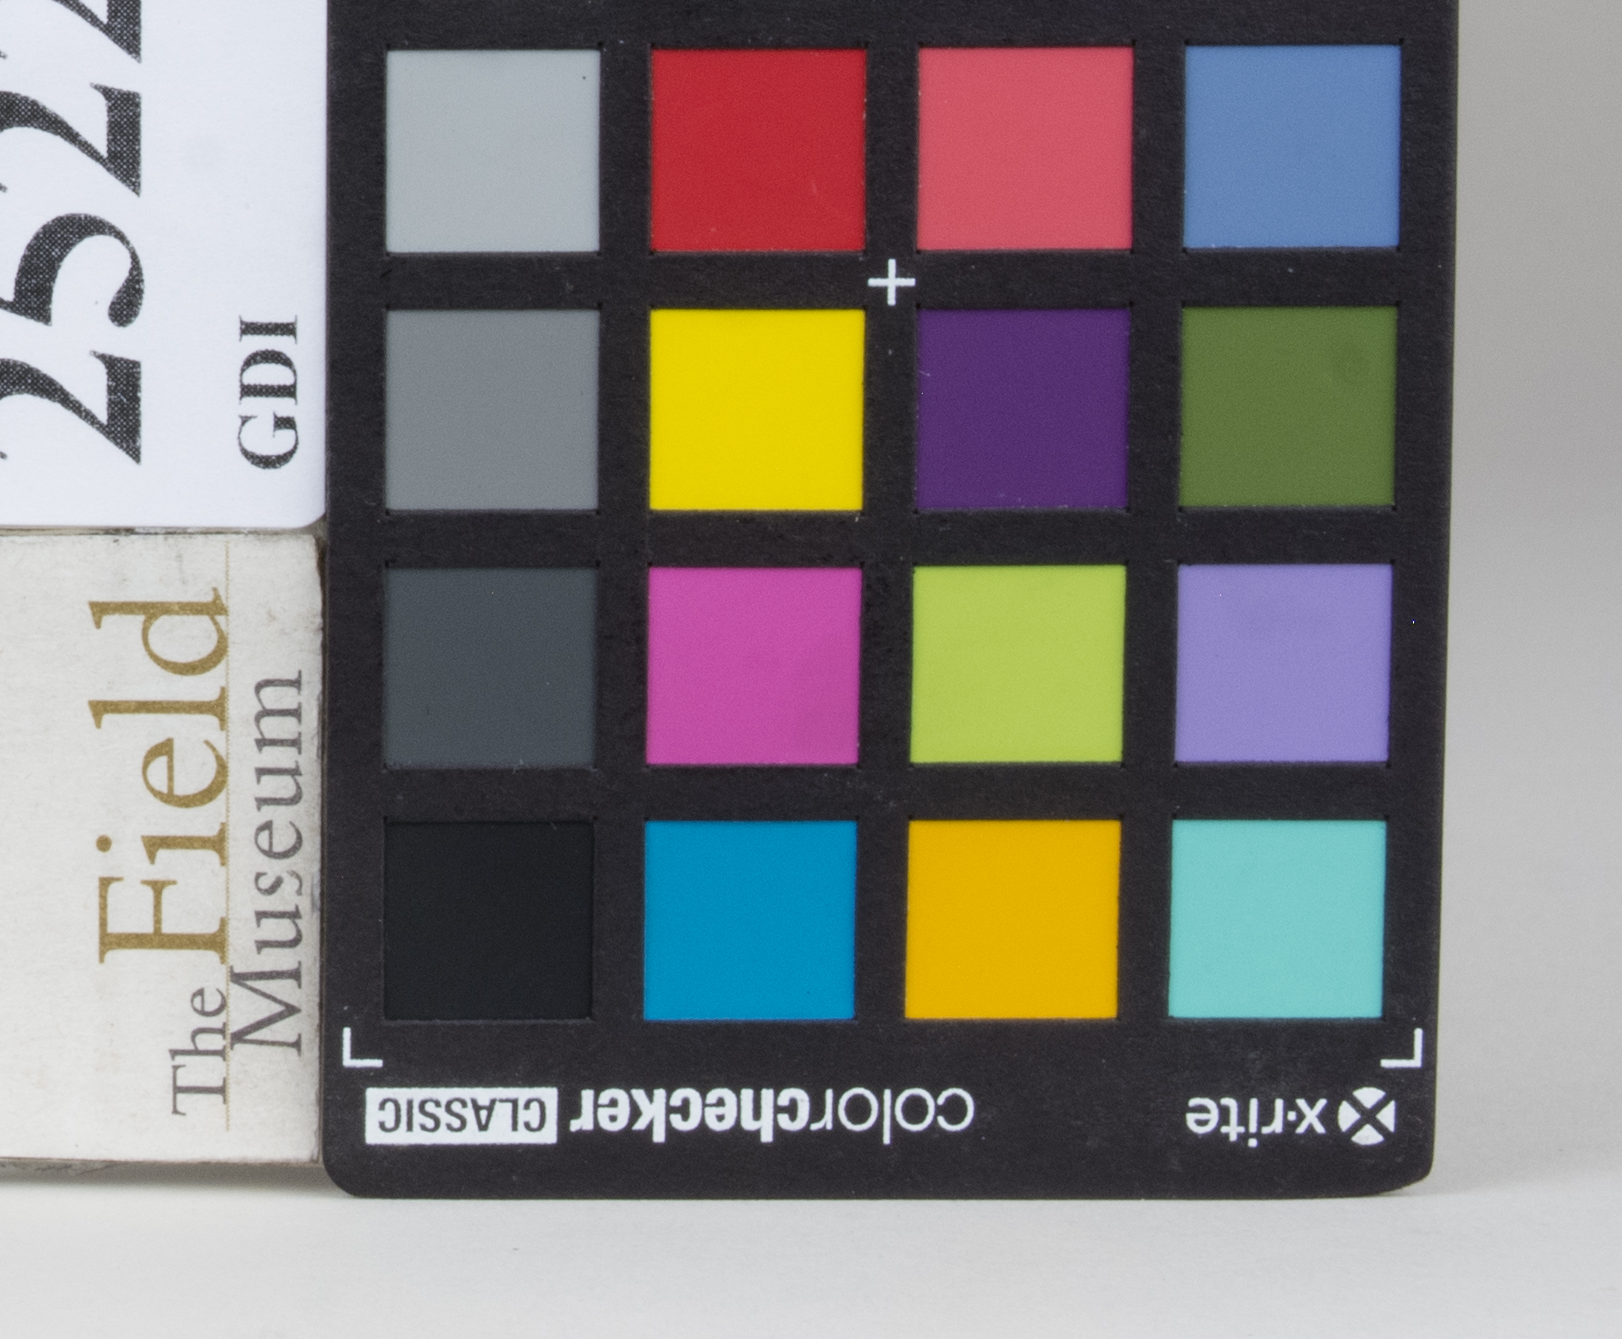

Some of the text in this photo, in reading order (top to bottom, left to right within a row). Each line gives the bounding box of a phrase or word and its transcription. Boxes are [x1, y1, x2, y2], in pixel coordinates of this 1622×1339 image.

[237, 314, 299, 471] GDI
[87, 586, 229, 1117] The Field
[228, 669, 302, 1053] Museum
[377, 1086, 975, 1145] colorchecker CLASSIC
